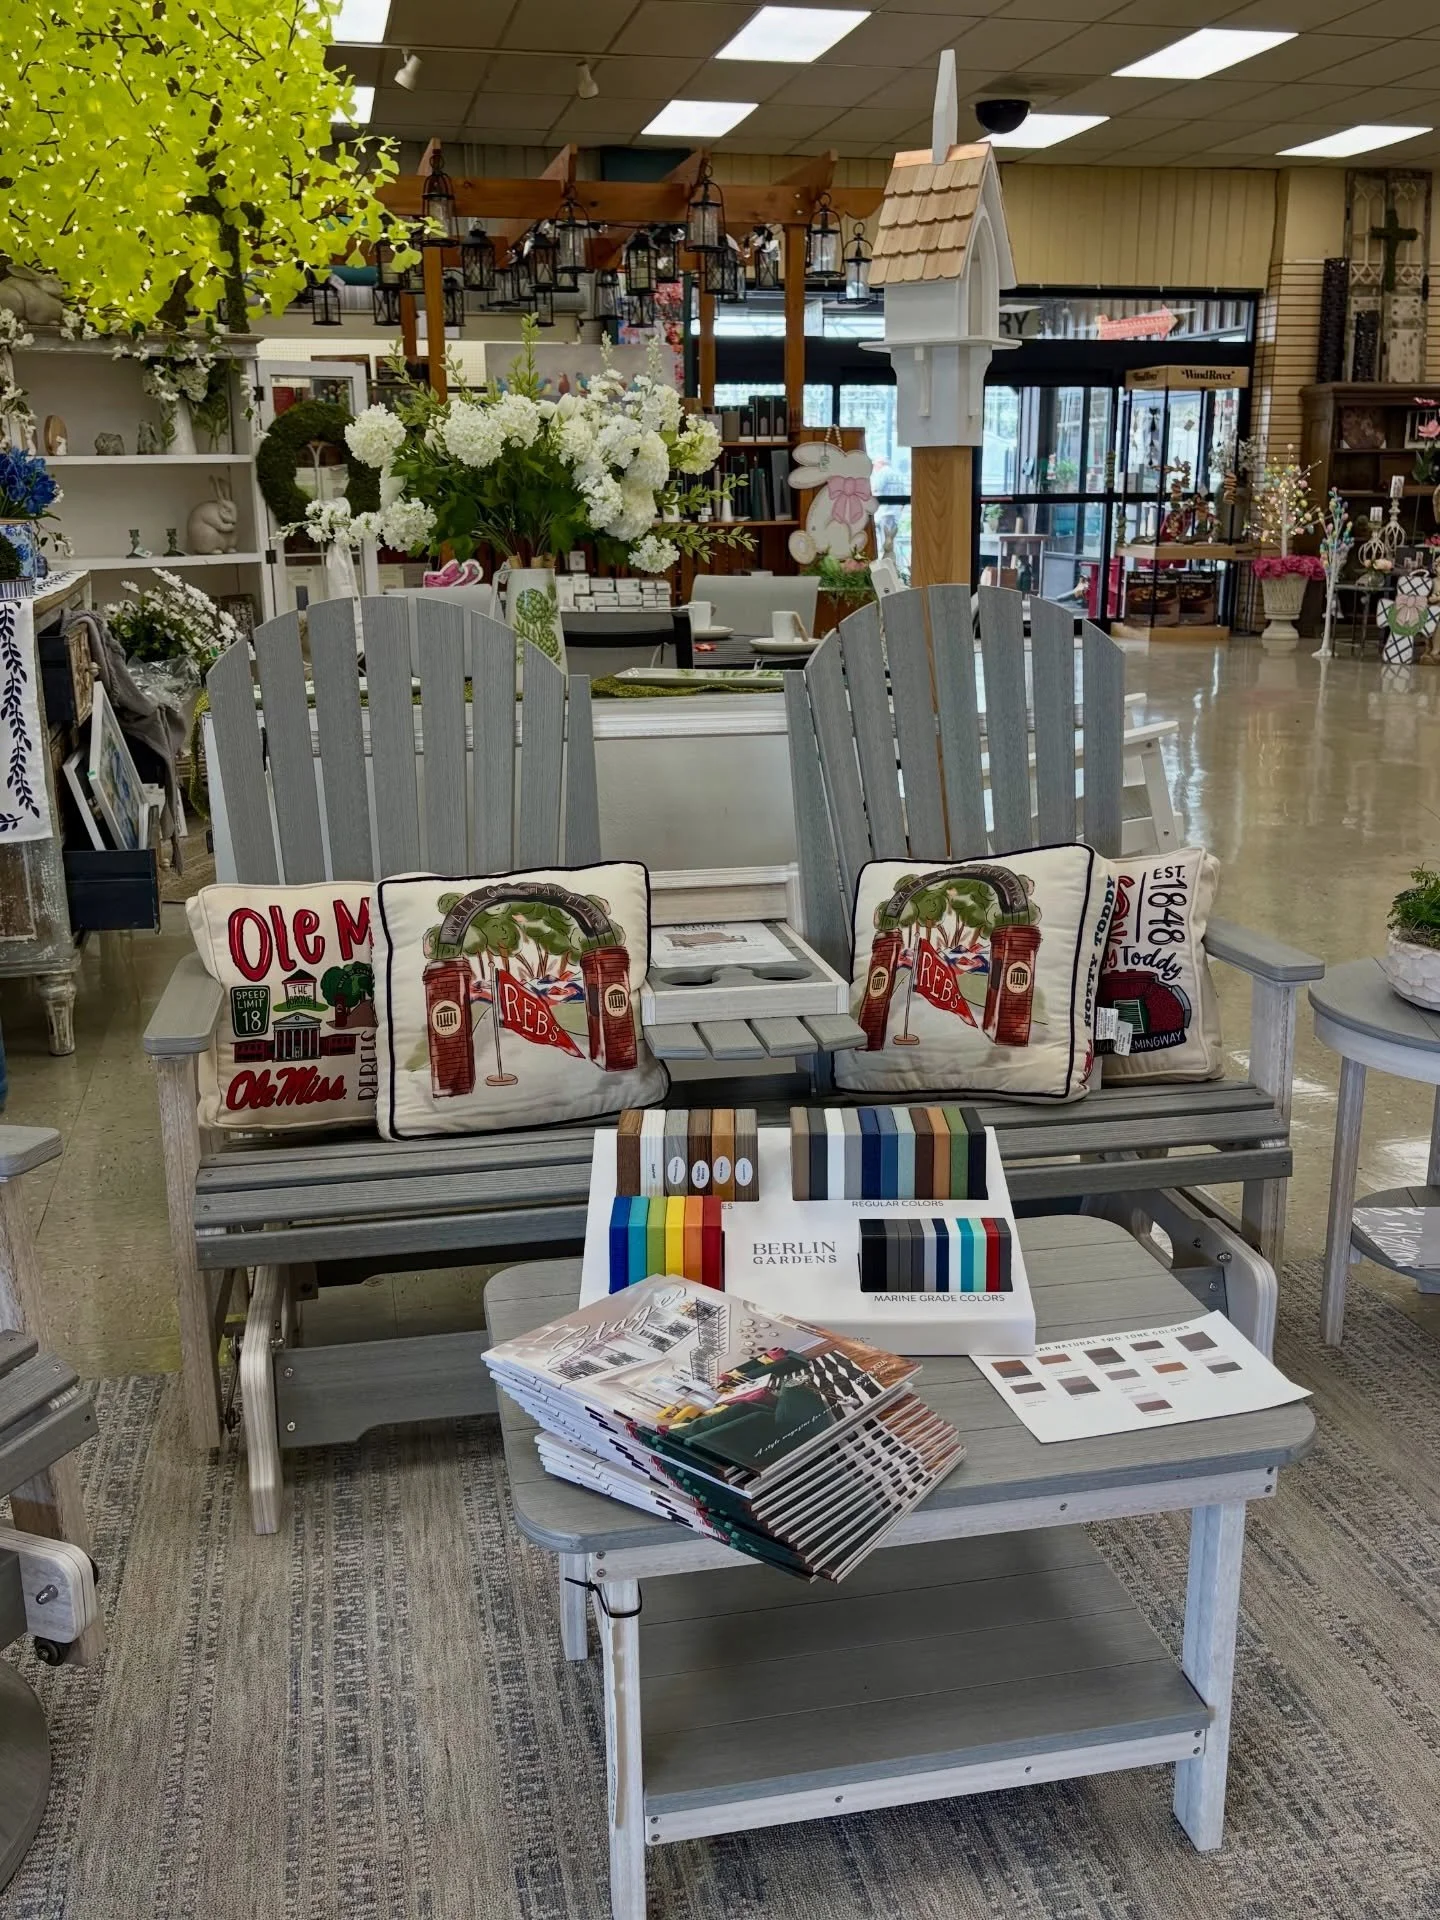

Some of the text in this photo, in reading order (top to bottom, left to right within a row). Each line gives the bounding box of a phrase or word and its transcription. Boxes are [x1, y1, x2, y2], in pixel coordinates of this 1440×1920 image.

[1153, 865, 1186, 879] EST.
[443, 896, 480, 937] WALK
[1094, 874, 1115, 946] TODDY
[1148, 879, 1188, 946] 1848
[228, 905, 326, 982] Ole
[1119, 946, 1183, 982] Toddy
[291, 985, 308, 995] THE
[919, 951, 962, 1009] REBS
[235, 990, 266, 1000] SPEED
[237, 1000, 263, 1009] LIMIT
[242, 1010, 262, 1032] 18
[503, 983, 560, 1043] REBS
[226, 1069, 279, 1111] Ole
[852, 1200, 900, 1208] REGULAR
[753, 1241, 836, 1255] BERLIN
[753, 1255, 837, 1265] GARDENS
[874, 1294, 1005, 1302] MARINE GRADE COLORS
[1054, 1340, 1098, 1351] NATURAL
[1152, 1325, 1191, 1335] COLORS
